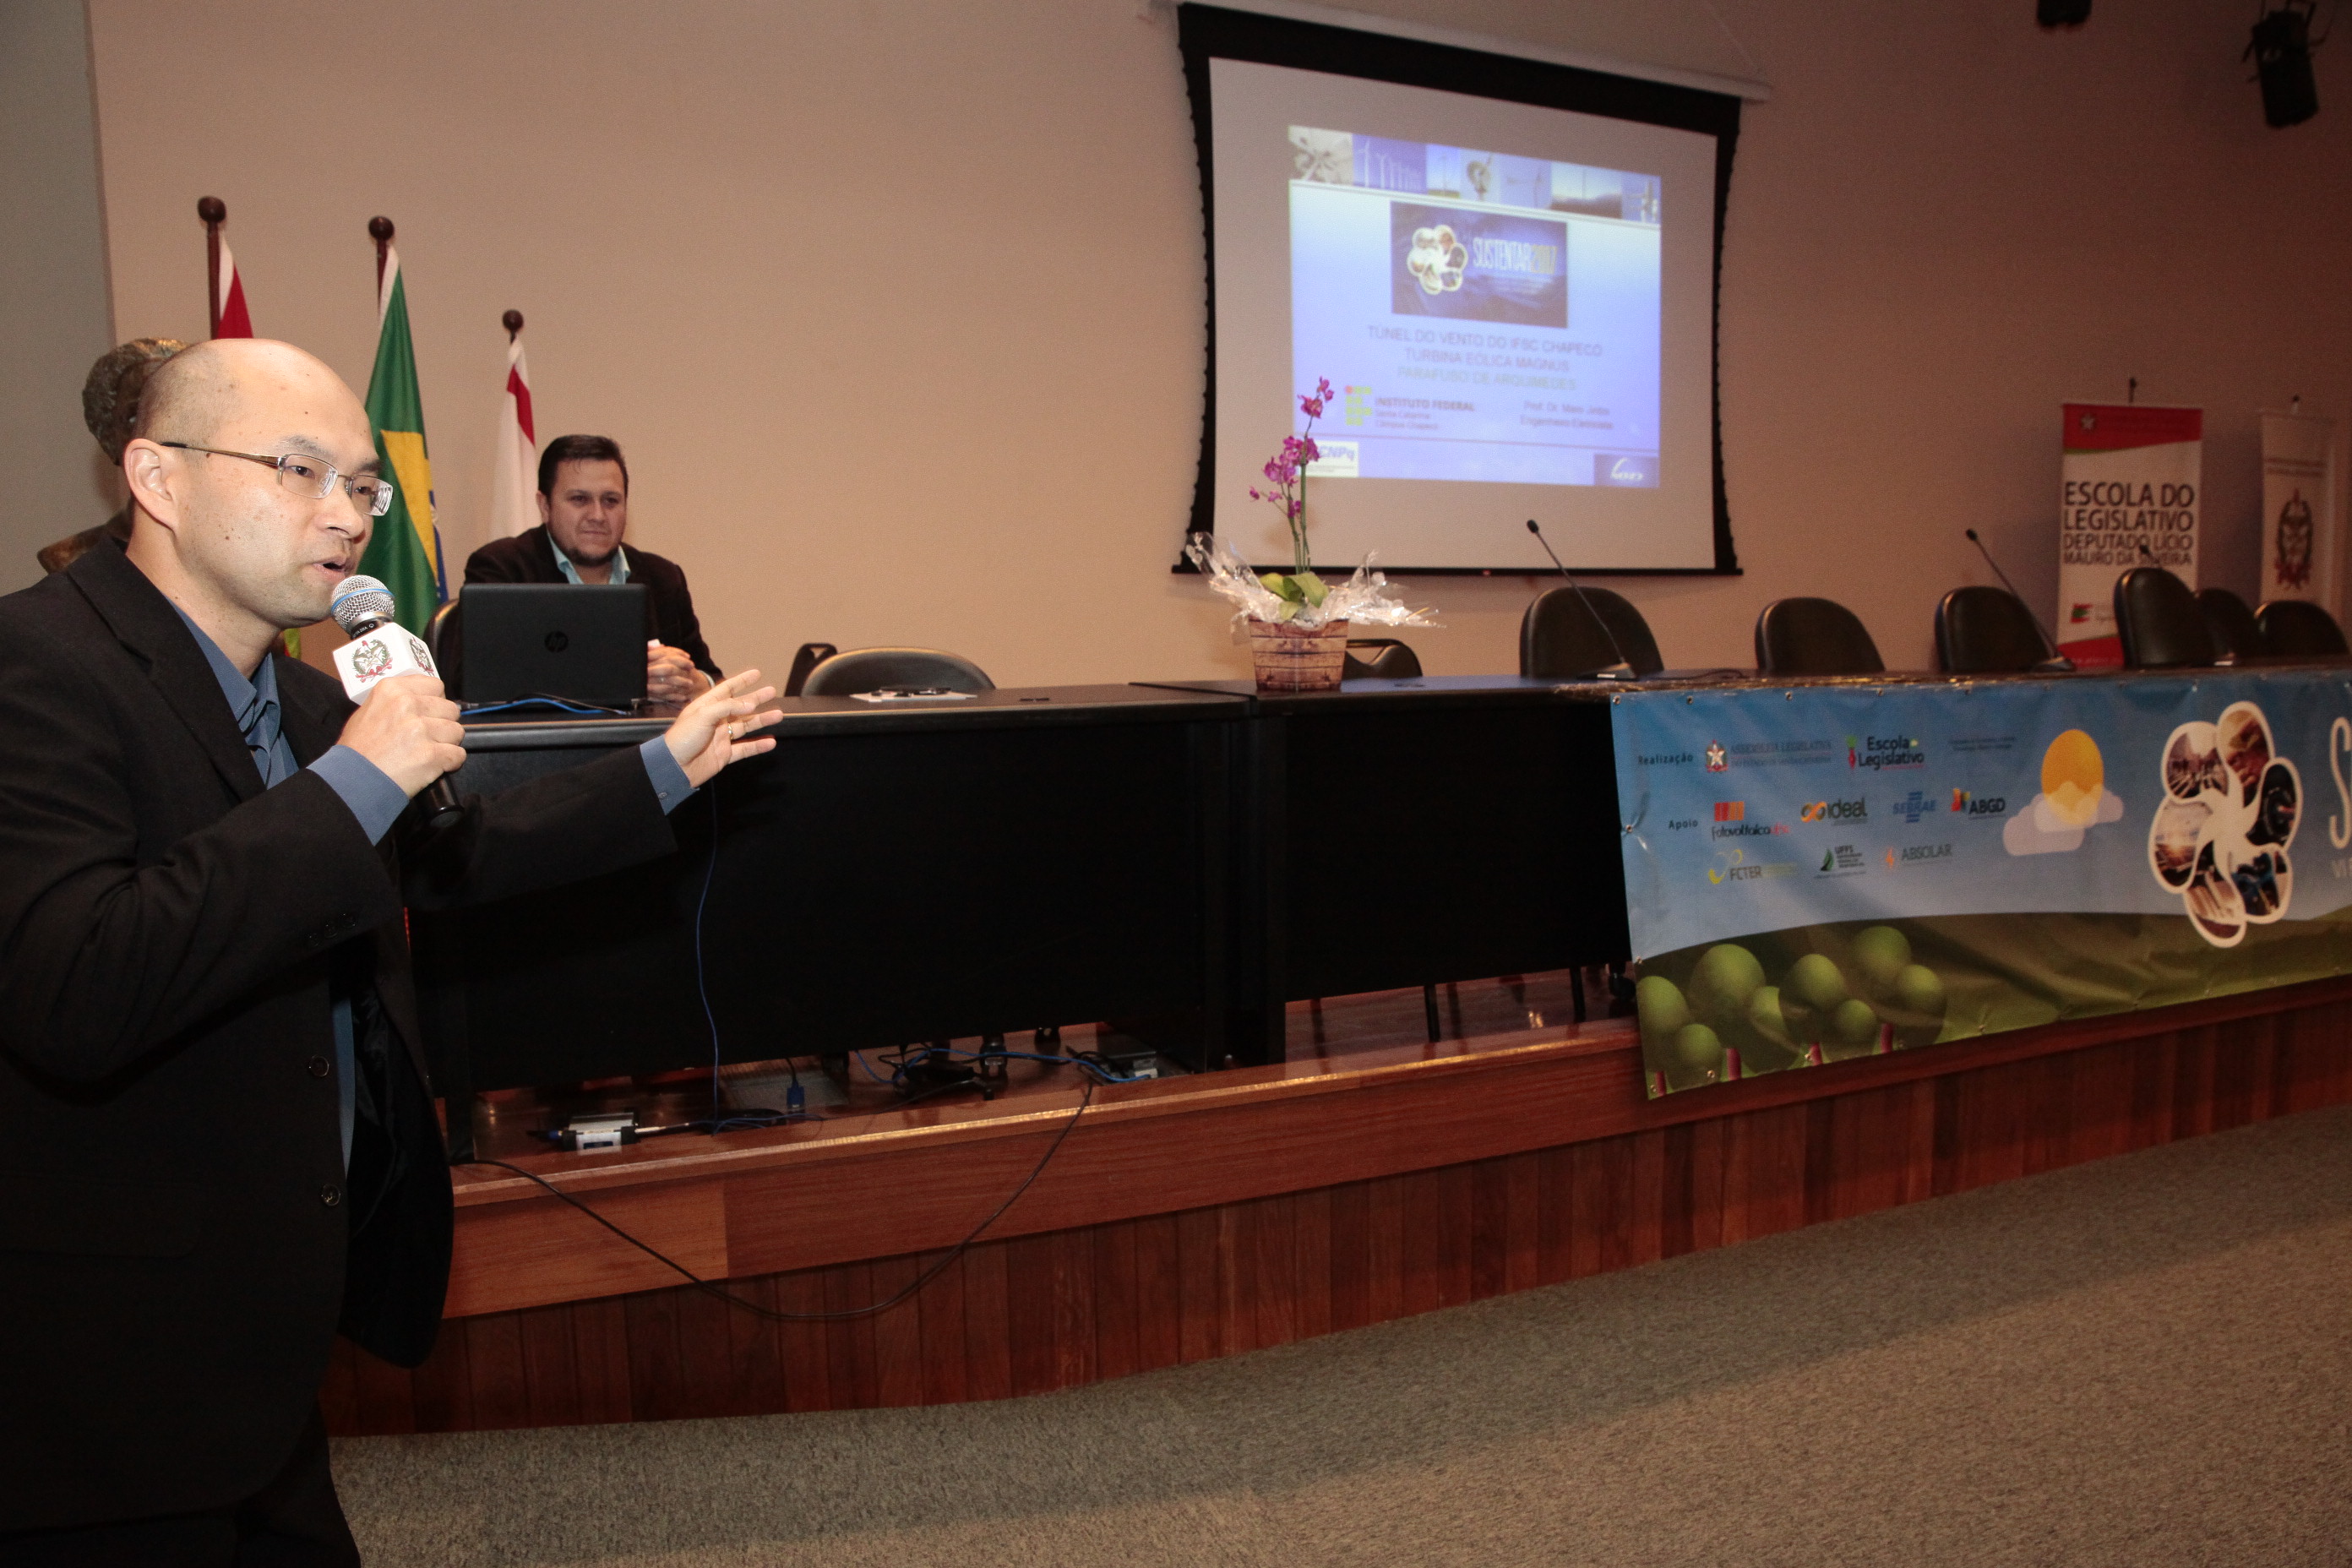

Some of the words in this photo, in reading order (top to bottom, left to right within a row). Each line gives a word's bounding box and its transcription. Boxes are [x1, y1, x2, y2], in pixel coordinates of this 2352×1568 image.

[1440, 331, 1484, 347] VENTO
[2065, 482, 2154, 507] ESCOLA
[2160, 483, 2195, 508] DO
[2064, 509, 2194, 531] LEGISLATIVO
[1867, 734, 1910, 751] Escola
[1859, 752, 1925, 770] Legislativo
[1968, 798, 2006, 815] ABGD
[1669, 819, 1698, 831] Apoio
[1901, 843, 1953, 860] ABSOLAR
